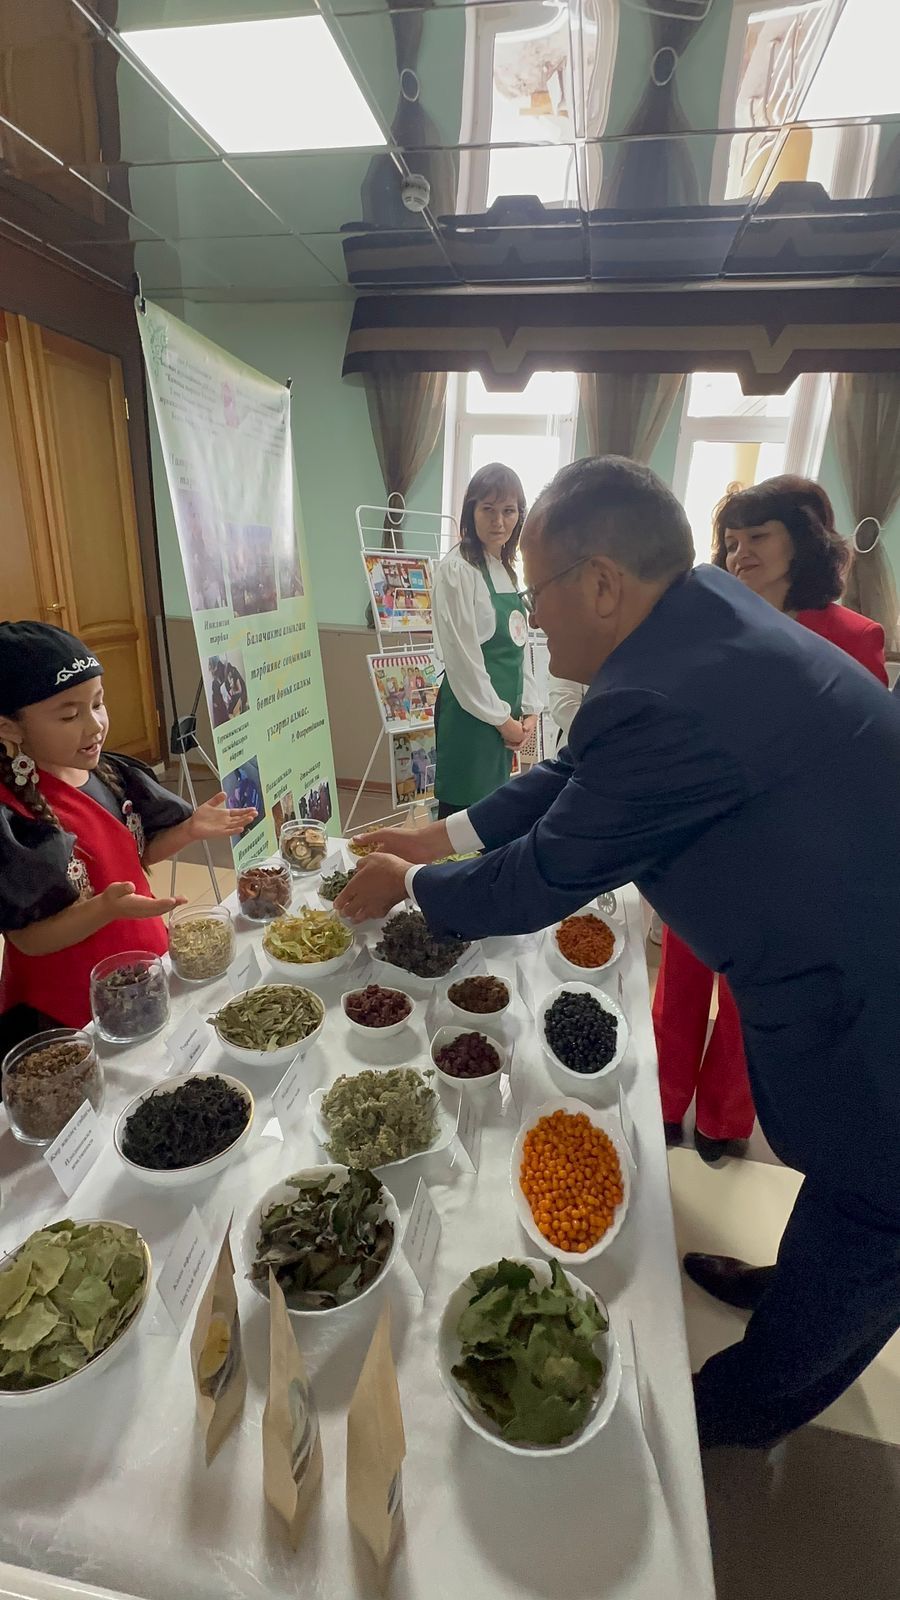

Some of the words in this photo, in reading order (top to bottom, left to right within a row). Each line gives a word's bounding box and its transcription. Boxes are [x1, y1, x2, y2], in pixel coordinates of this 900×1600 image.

[209, 632, 229, 645] тәрбия
[246, 628, 282, 646] Балачакта
[283, 621, 307, 635] алынган
[250, 660, 281, 680] тәрбияне
[256, 693, 276, 711] бөтен
[276, 686, 293, 701] дөнья
[293, 677, 312, 693] халкы
[266, 715, 290, 741] үзгәртә
[290, 706, 310, 724] алмас.
